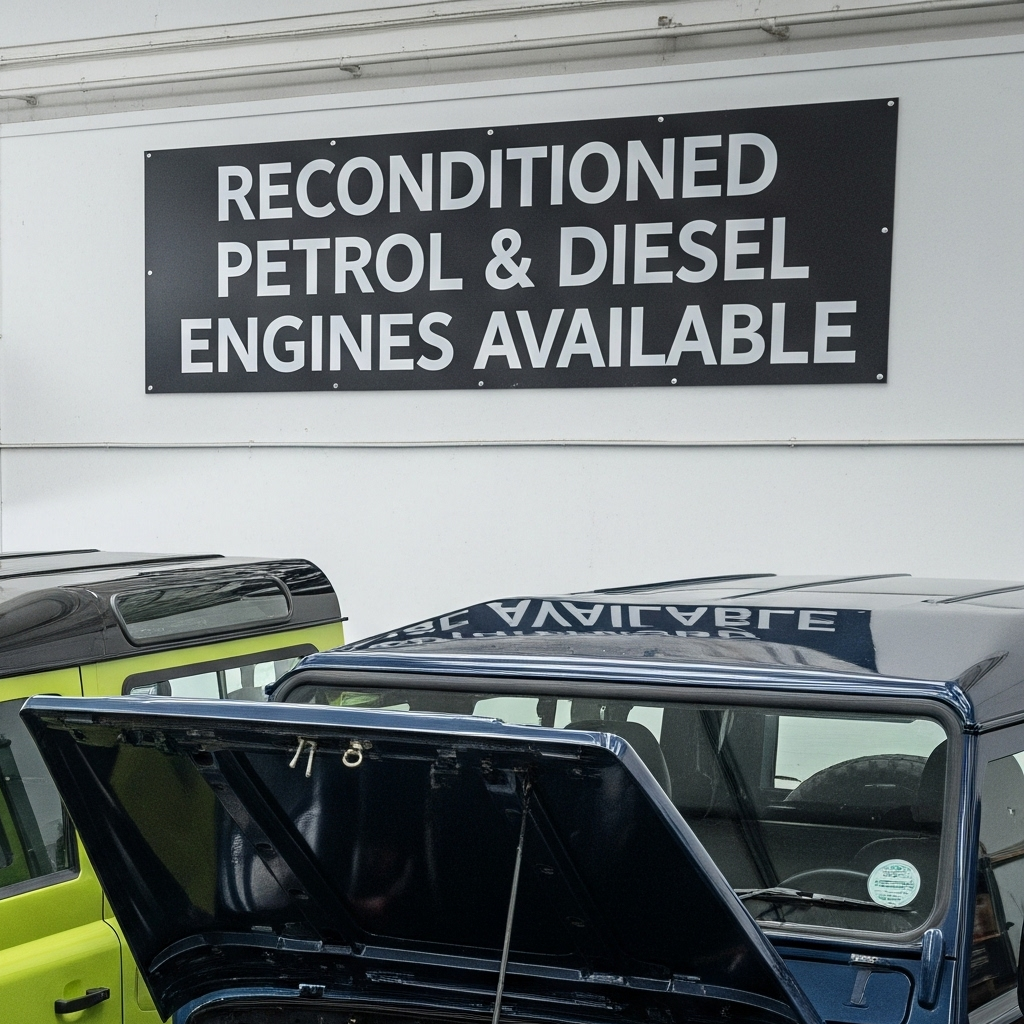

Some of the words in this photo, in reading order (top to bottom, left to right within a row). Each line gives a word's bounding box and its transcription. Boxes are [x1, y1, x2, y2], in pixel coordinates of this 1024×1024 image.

[217, 132, 778, 222] RECONDITIONED
[217, 232, 464, 298] PETROL
[484, 227, 535, 291] &
[558, 216, 810, 287] DIESEL
[180, 311, 454, 374] ENGINES
[472, 300, 857, 370] AVAILABLE
